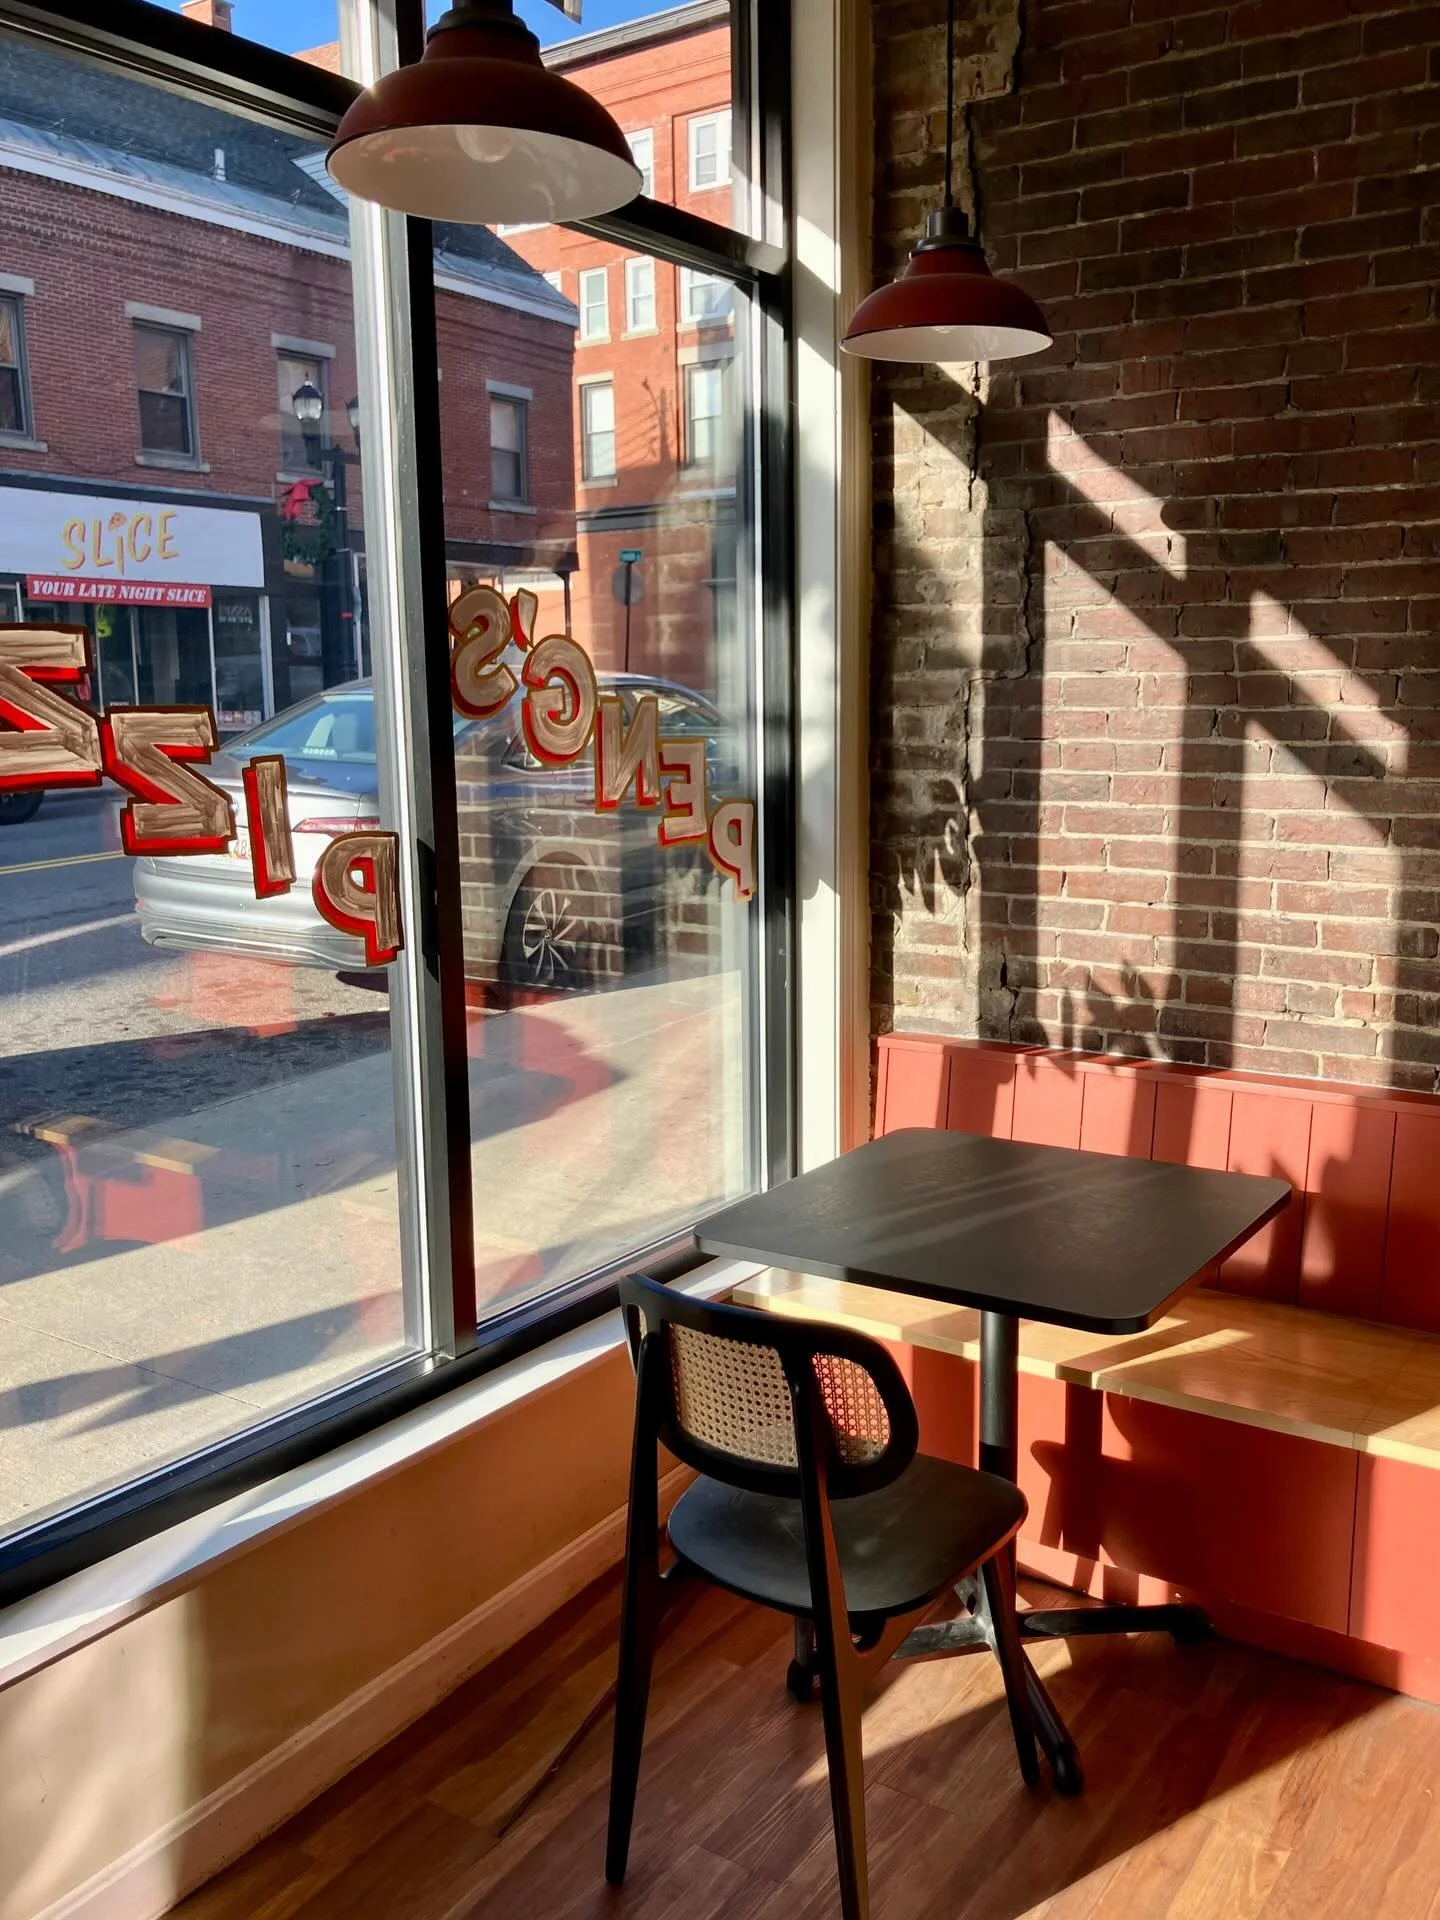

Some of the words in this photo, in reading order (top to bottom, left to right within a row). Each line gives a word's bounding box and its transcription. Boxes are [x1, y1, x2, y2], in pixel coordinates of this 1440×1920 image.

[33, 580, 74, 596] YOUR
[79, 582, 115, 599] LATE
[120, 586, 165, 602] NIGHT
[166, 589, 206, 603] SLICE
